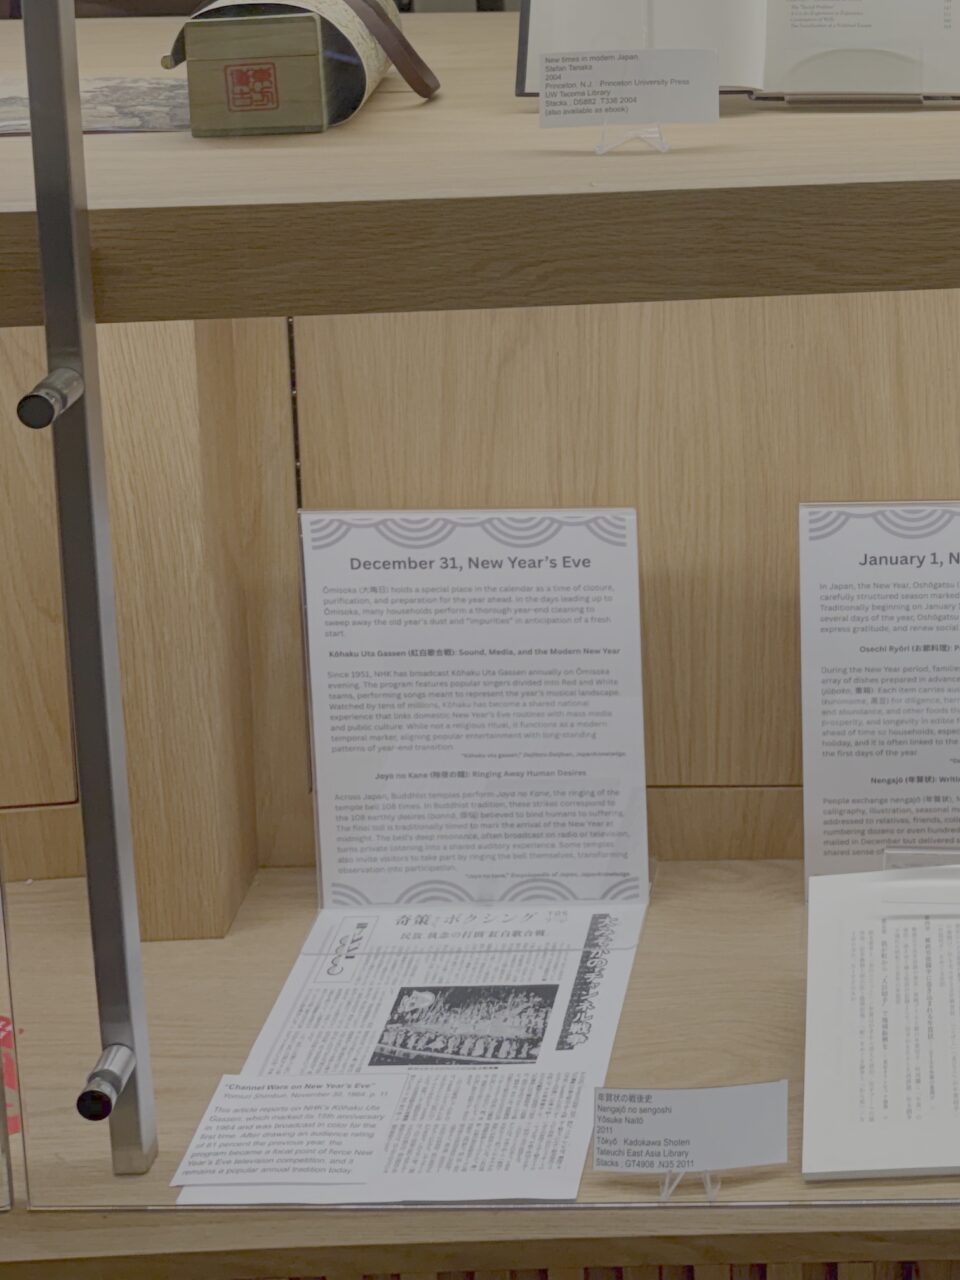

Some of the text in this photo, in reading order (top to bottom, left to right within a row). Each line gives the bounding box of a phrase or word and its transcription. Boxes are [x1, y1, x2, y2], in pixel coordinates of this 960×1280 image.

[349, 555, 591, 572] December 31, New Year’s Eve
[859, 551, 926, 568] January
[930, 551, 943, 567] 1,
